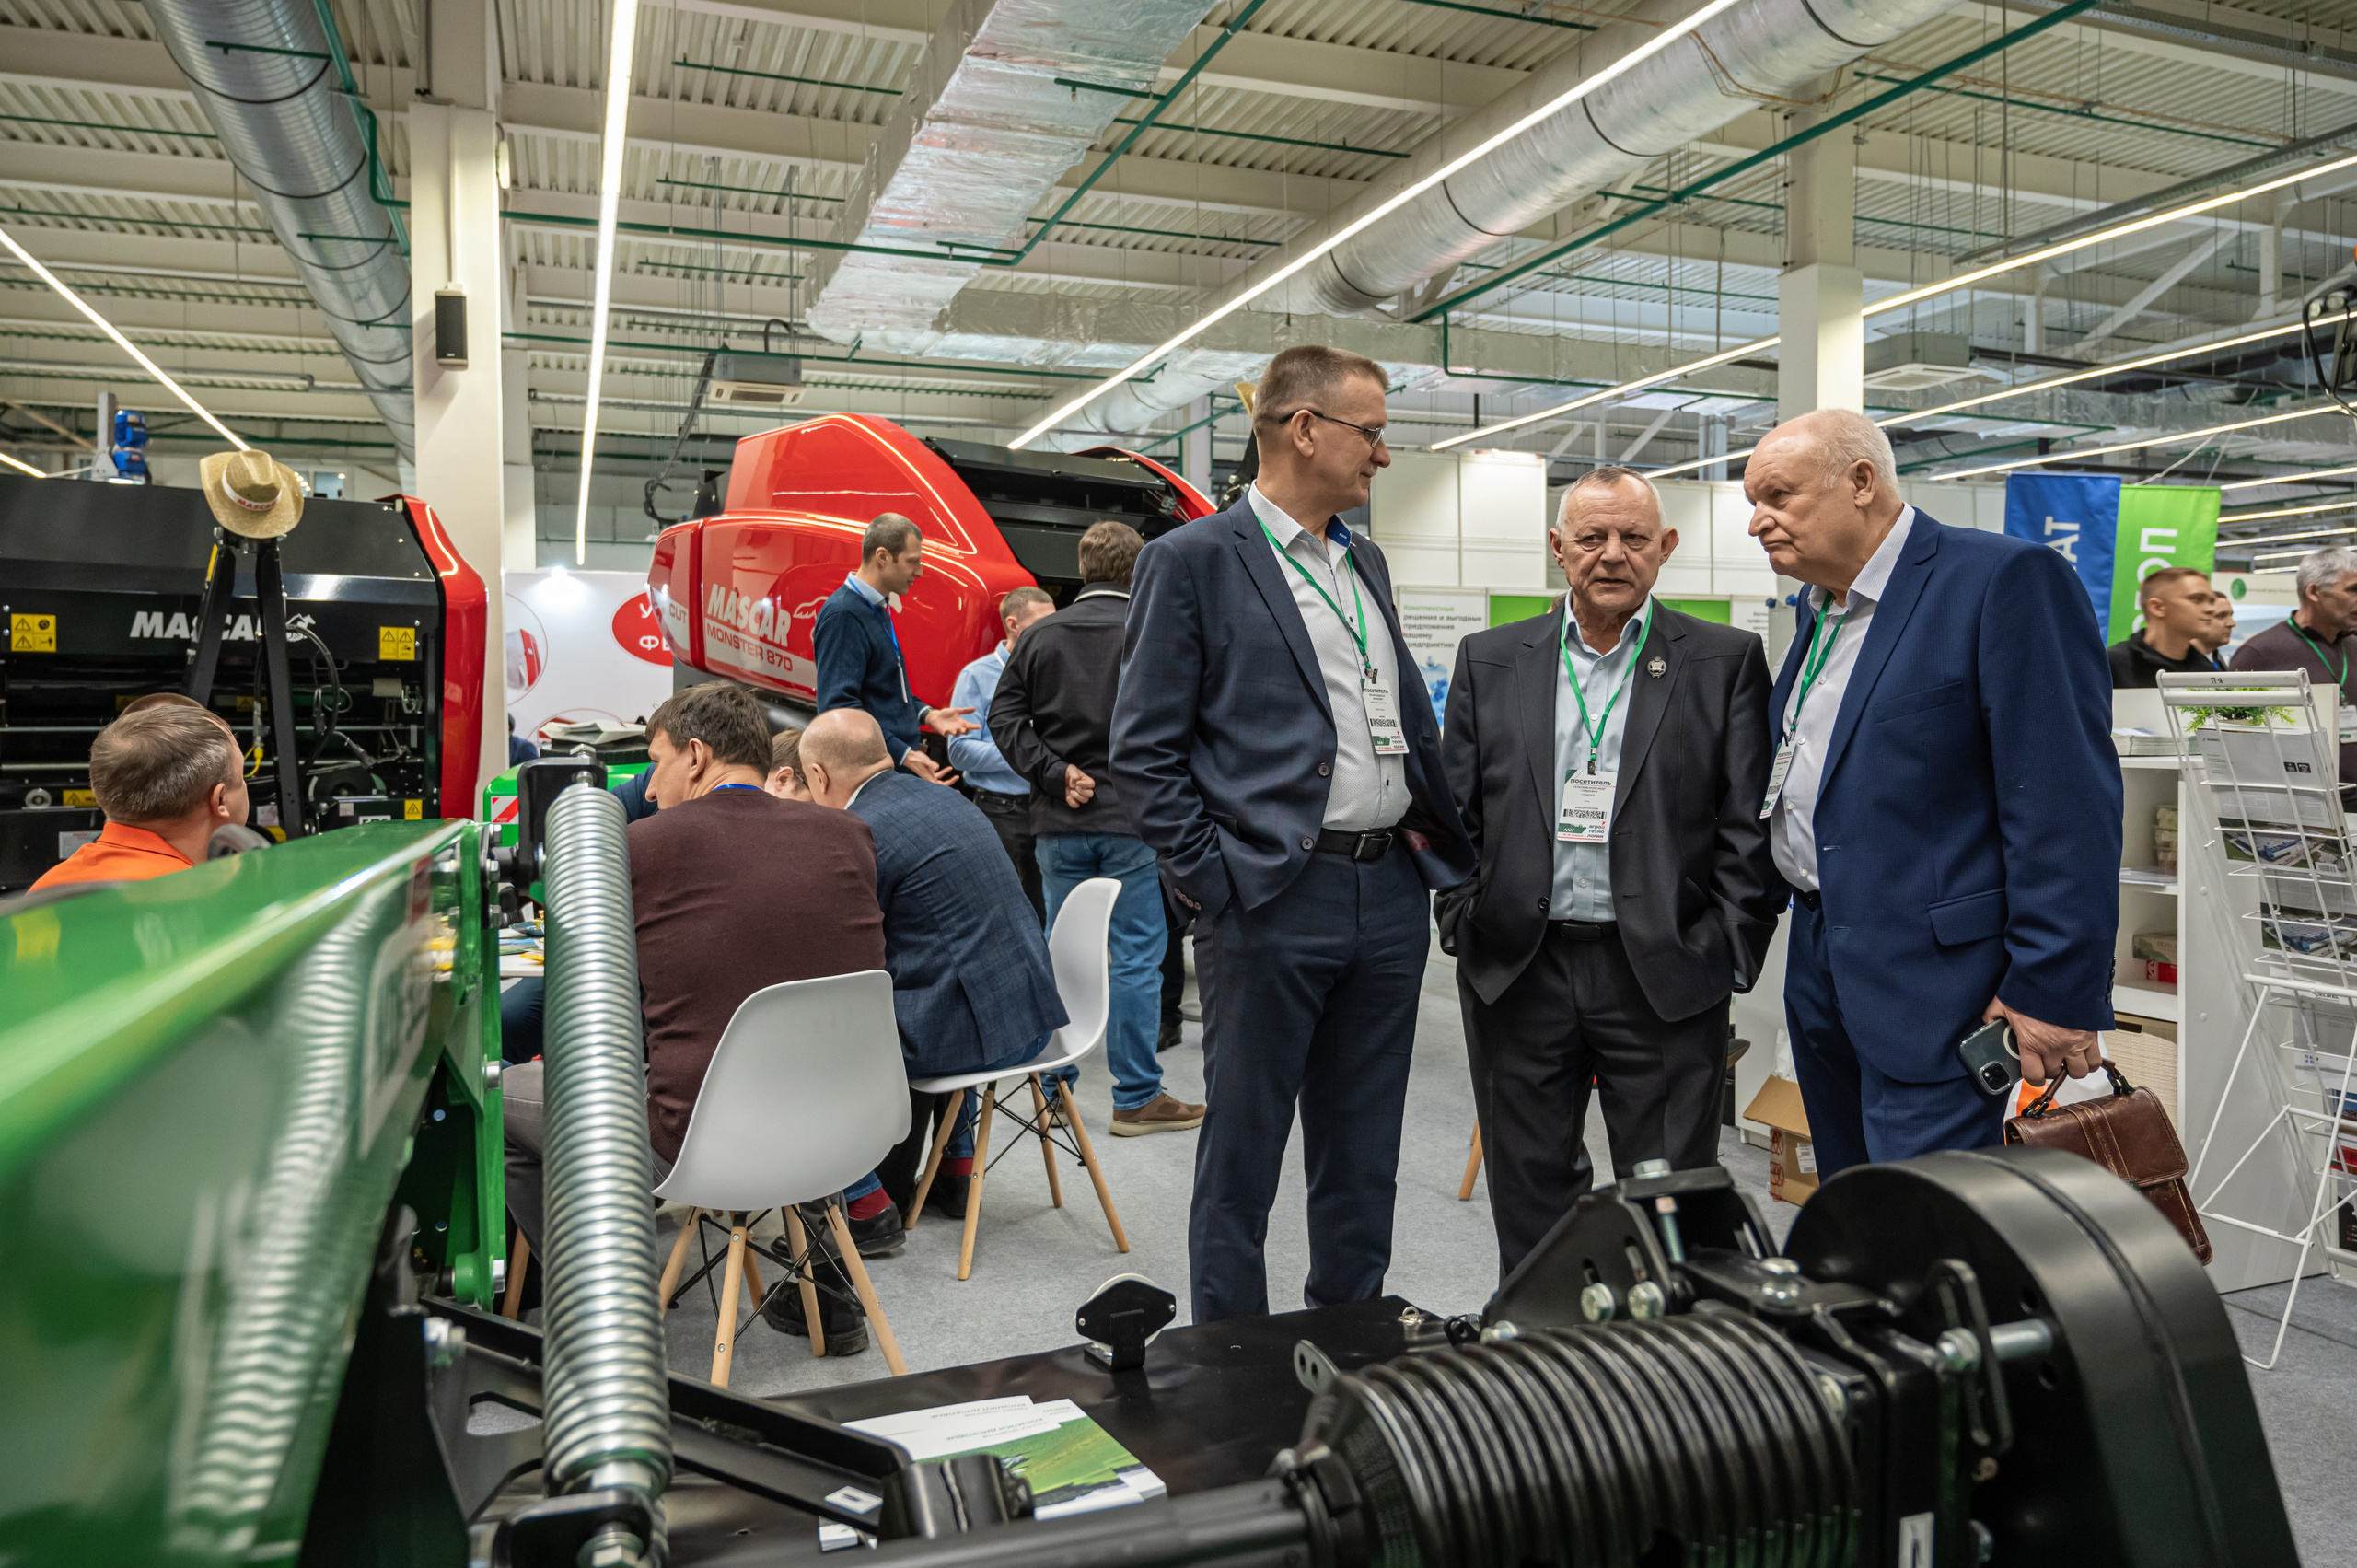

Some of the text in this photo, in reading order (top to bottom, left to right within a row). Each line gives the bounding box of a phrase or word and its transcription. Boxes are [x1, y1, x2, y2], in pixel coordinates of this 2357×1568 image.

[668, 602, 689, 624] CUT
[707, 583, 791, 647] MASCAR
[1403, 604, 1455, 612] Комплексные
[707, 623, 794, 673] MONSTER 870
